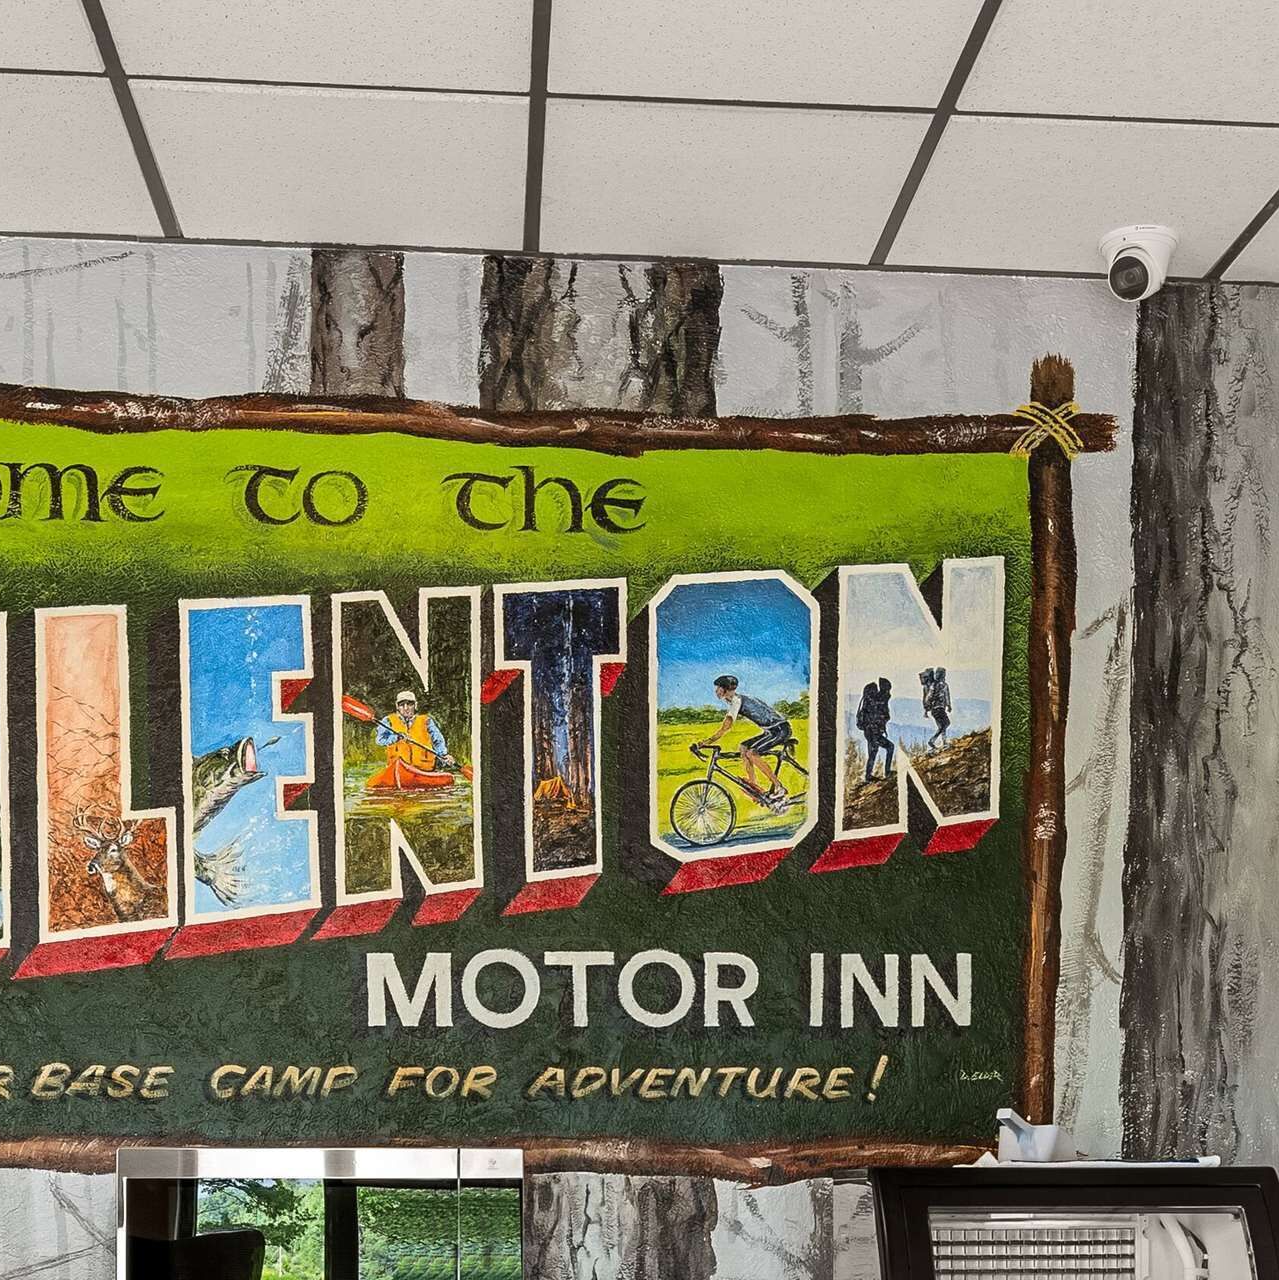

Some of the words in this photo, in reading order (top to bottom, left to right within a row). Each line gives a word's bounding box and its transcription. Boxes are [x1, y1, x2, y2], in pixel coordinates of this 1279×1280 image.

[367, 948, 759, 1028] MOTOR
[809, 951, 973, 1028] INN
[31, 1062, 175, 1100] BASE
[210, 1064, 360, 1099] CAMP
[387, 1065, 499, 1098] FOR
[528, 1054, 890, 1102] ADVENTURE!
